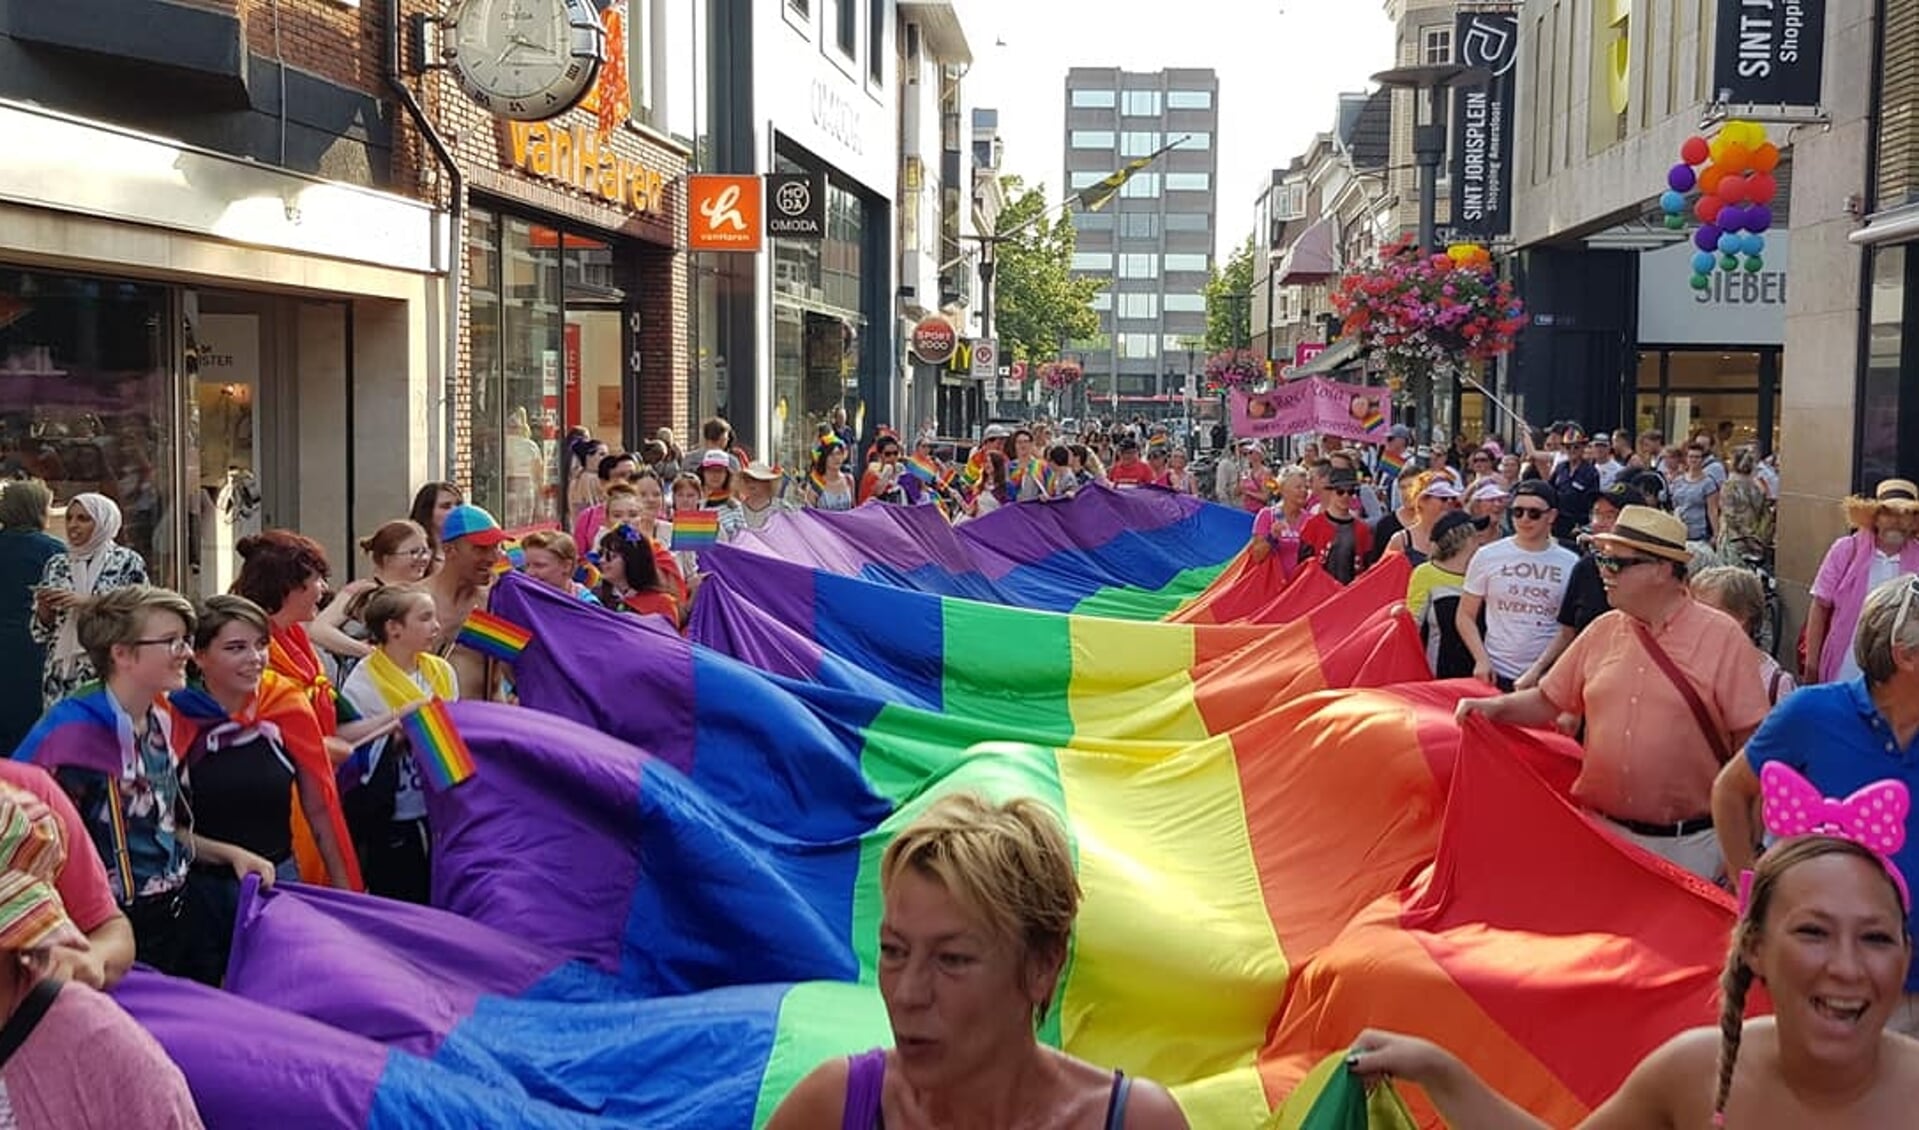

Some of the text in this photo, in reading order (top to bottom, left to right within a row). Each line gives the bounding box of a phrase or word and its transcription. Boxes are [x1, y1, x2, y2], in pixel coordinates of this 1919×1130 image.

[1738, 15, 1773, 77] SINT
[1463, 92, 1487, 221] SINT JORISPLEIN
[509, 120, 664, 215] vanHaren
[1486, 161, 1502, 212] Shopping
[770, 219, 819, 232] OMODA
[700, 233, 750, 241] vanHaren
[916, 330, 952, 341] SPORT
[919, 341, 949, 351] 2000
[1501, 562, 1562, 583] LOVE
[1523, 586, 1551, 600] FOR
